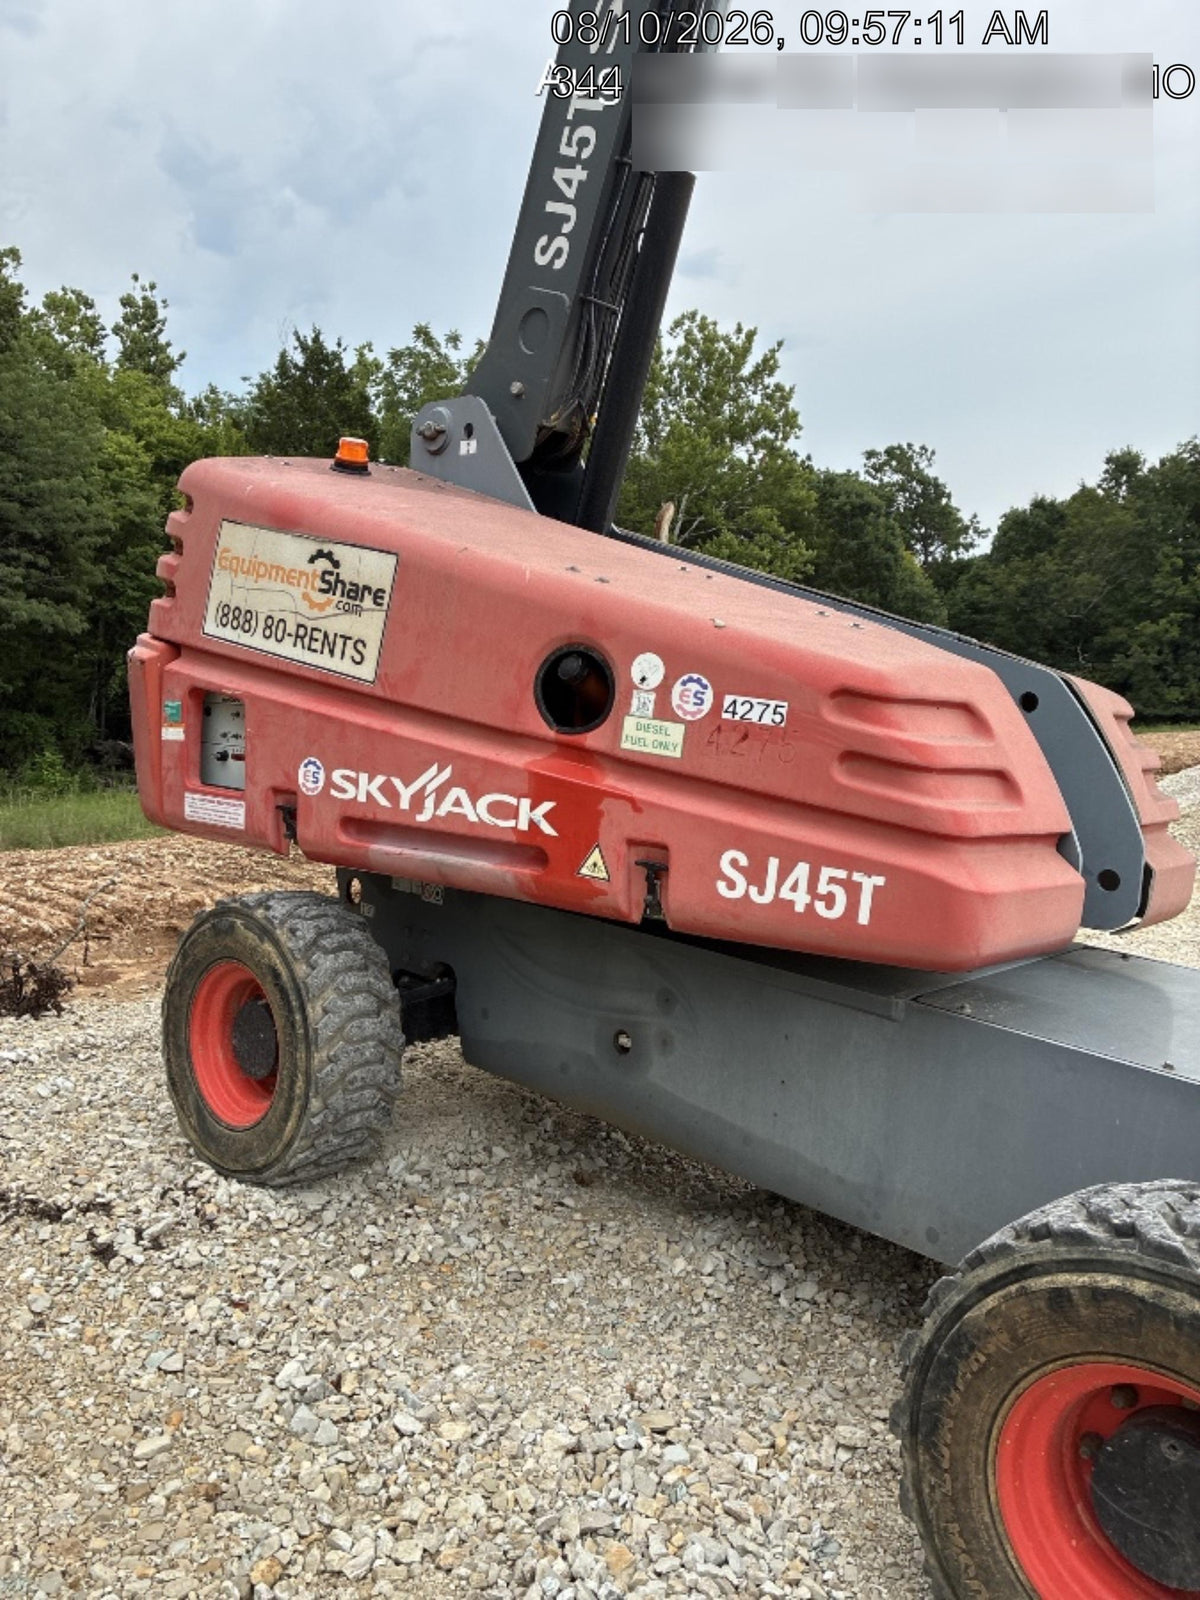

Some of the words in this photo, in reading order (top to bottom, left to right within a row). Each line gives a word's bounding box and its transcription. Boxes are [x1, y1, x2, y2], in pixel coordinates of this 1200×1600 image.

[534, 86, 604, 270] SJ45T
[215, 600, 259, 637] (888)
[262, 614, 367, 666] 80-RENTS
[624, 734, 648, 748] FUEL
[635, 721, 671, 737] DIESEL
[723, 698, 786, 726] 4275
[330, 762, 559, 837] SKYJACK
[716, 849, 886, 926] SJ45T
